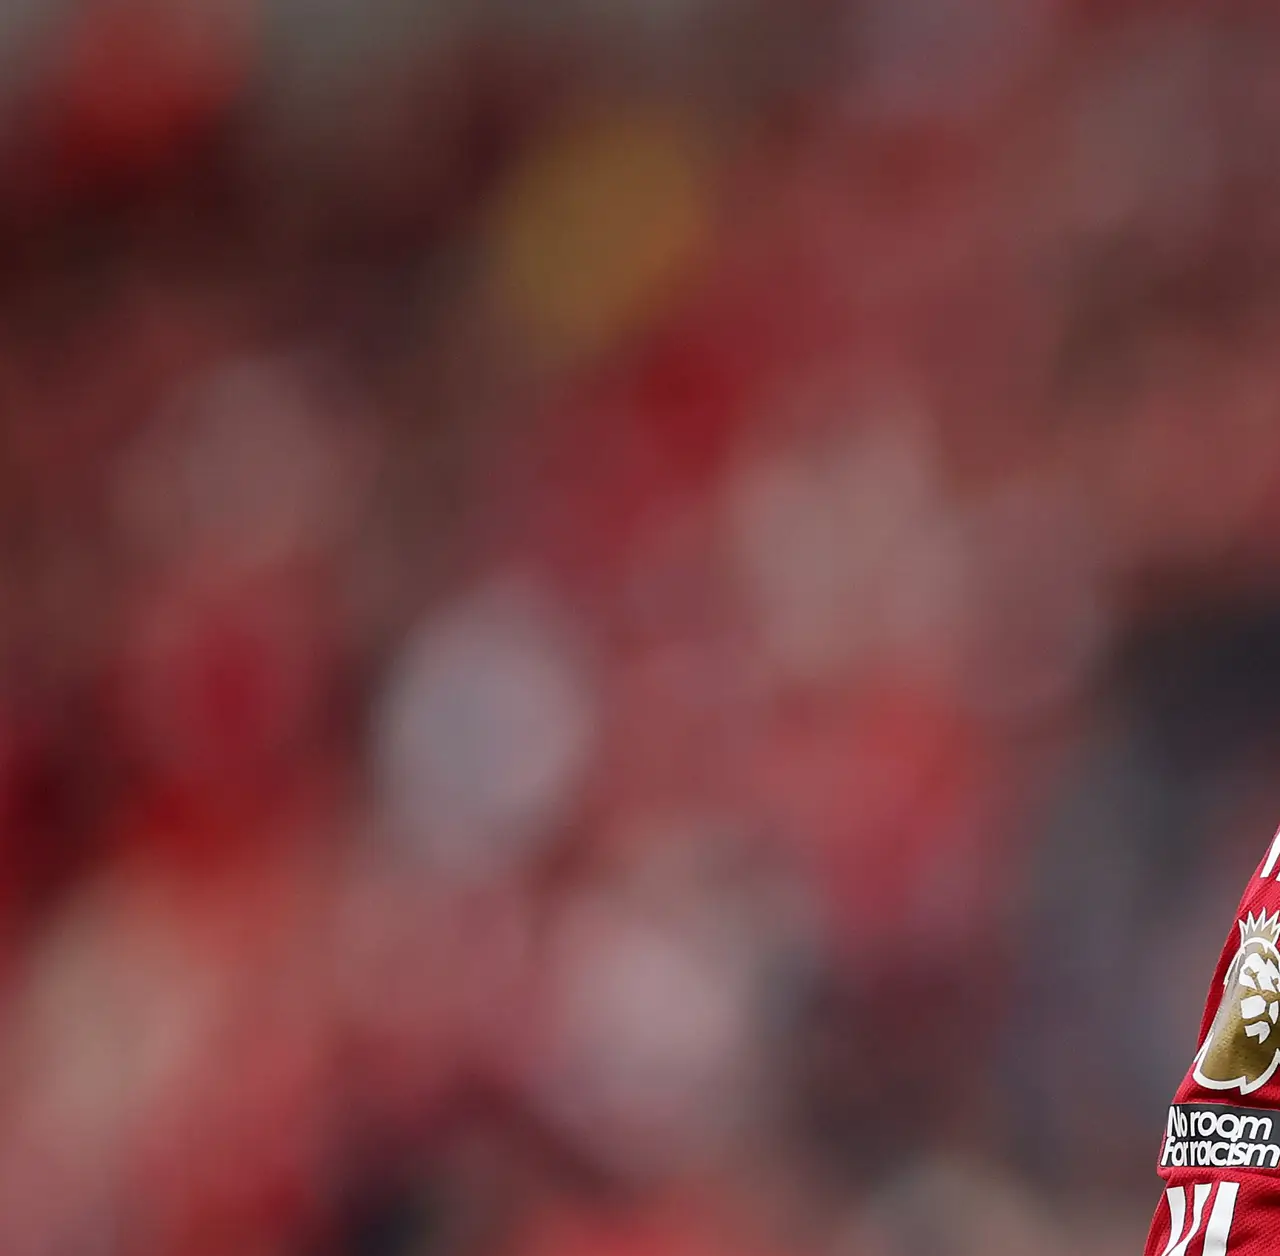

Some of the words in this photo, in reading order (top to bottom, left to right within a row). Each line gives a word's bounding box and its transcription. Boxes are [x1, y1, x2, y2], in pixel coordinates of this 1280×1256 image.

[1166, 1105, 1189, 1138] No
[1190, 1111, 1273, 1141] room
[1190, 1138, 1280, 1168] racism
